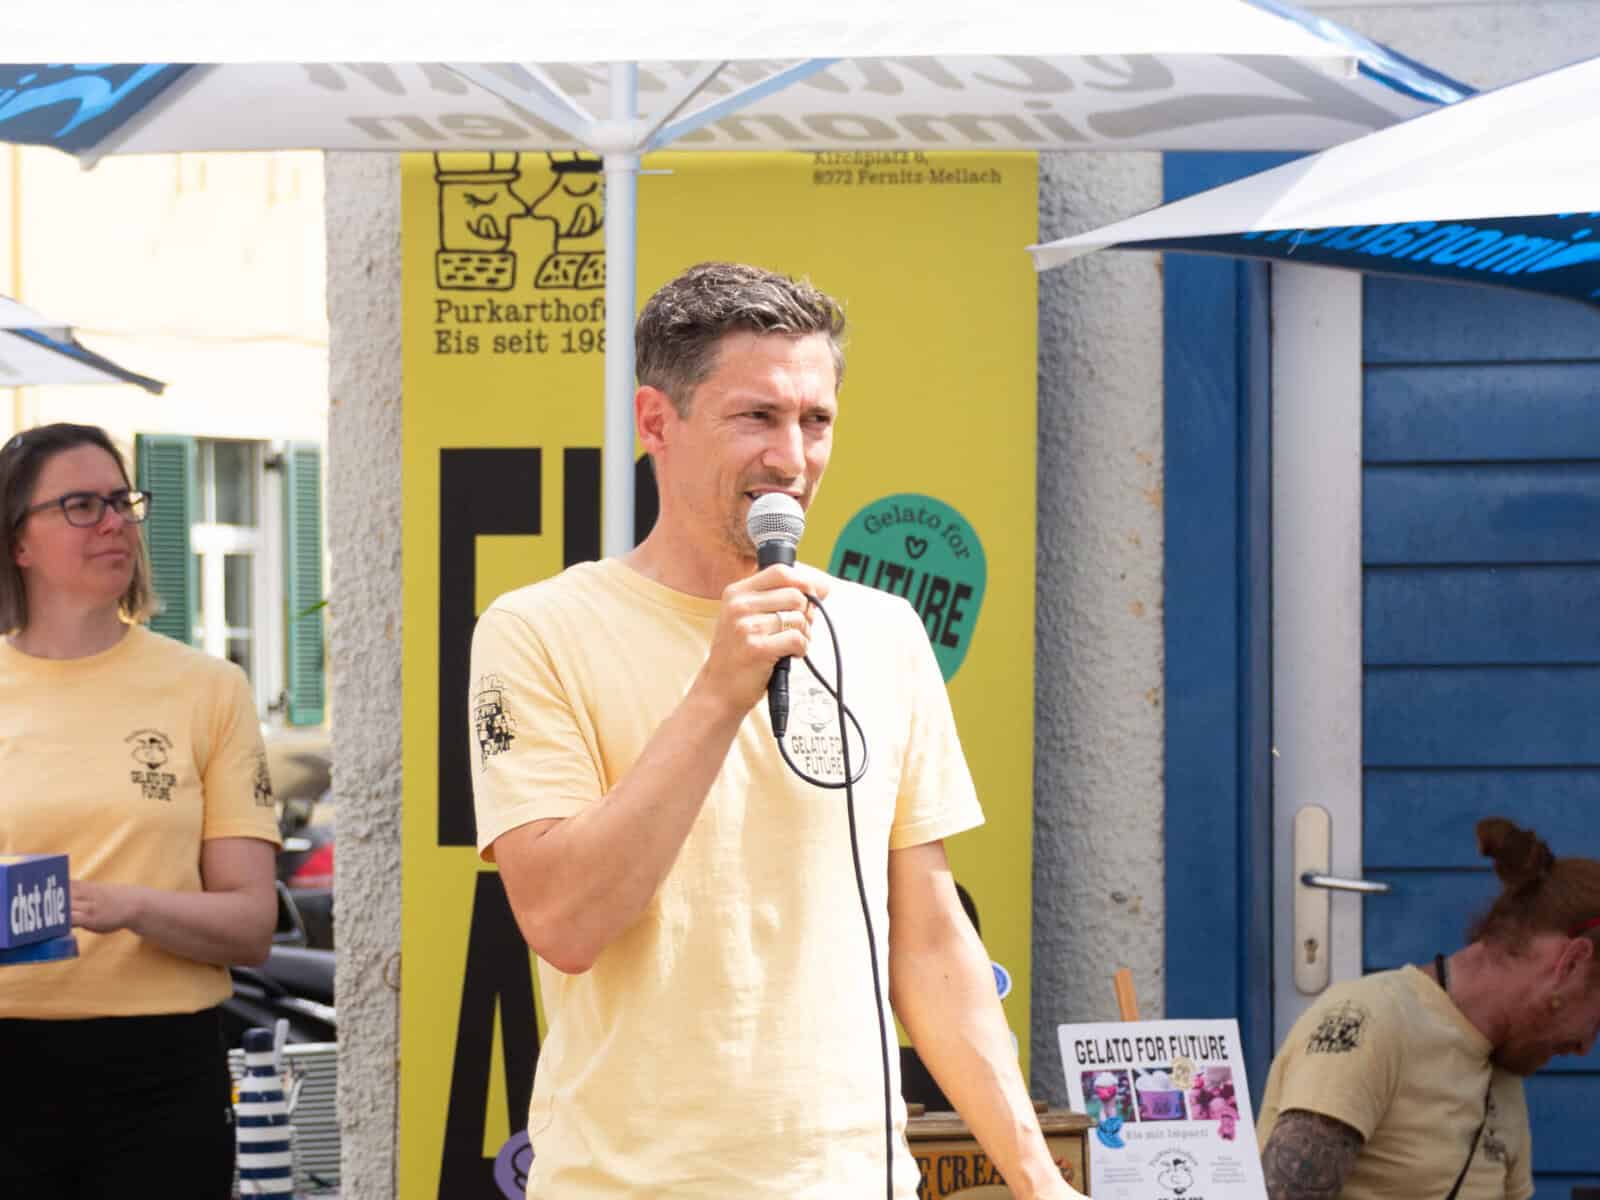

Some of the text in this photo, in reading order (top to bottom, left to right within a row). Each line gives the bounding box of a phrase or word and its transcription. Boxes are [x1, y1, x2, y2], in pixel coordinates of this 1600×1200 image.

[434, 297, 606, 324] Purkarthof
[434, 327, 606, 355] Eis seit 198
[864, 506, 970, 559] Gelato for
[791, 735, 826, 754] GELATO
[1074, 1035, 1229, 1065] GELATO FOR FUTURE
[937, 1154, 1008, 1198] CREA
